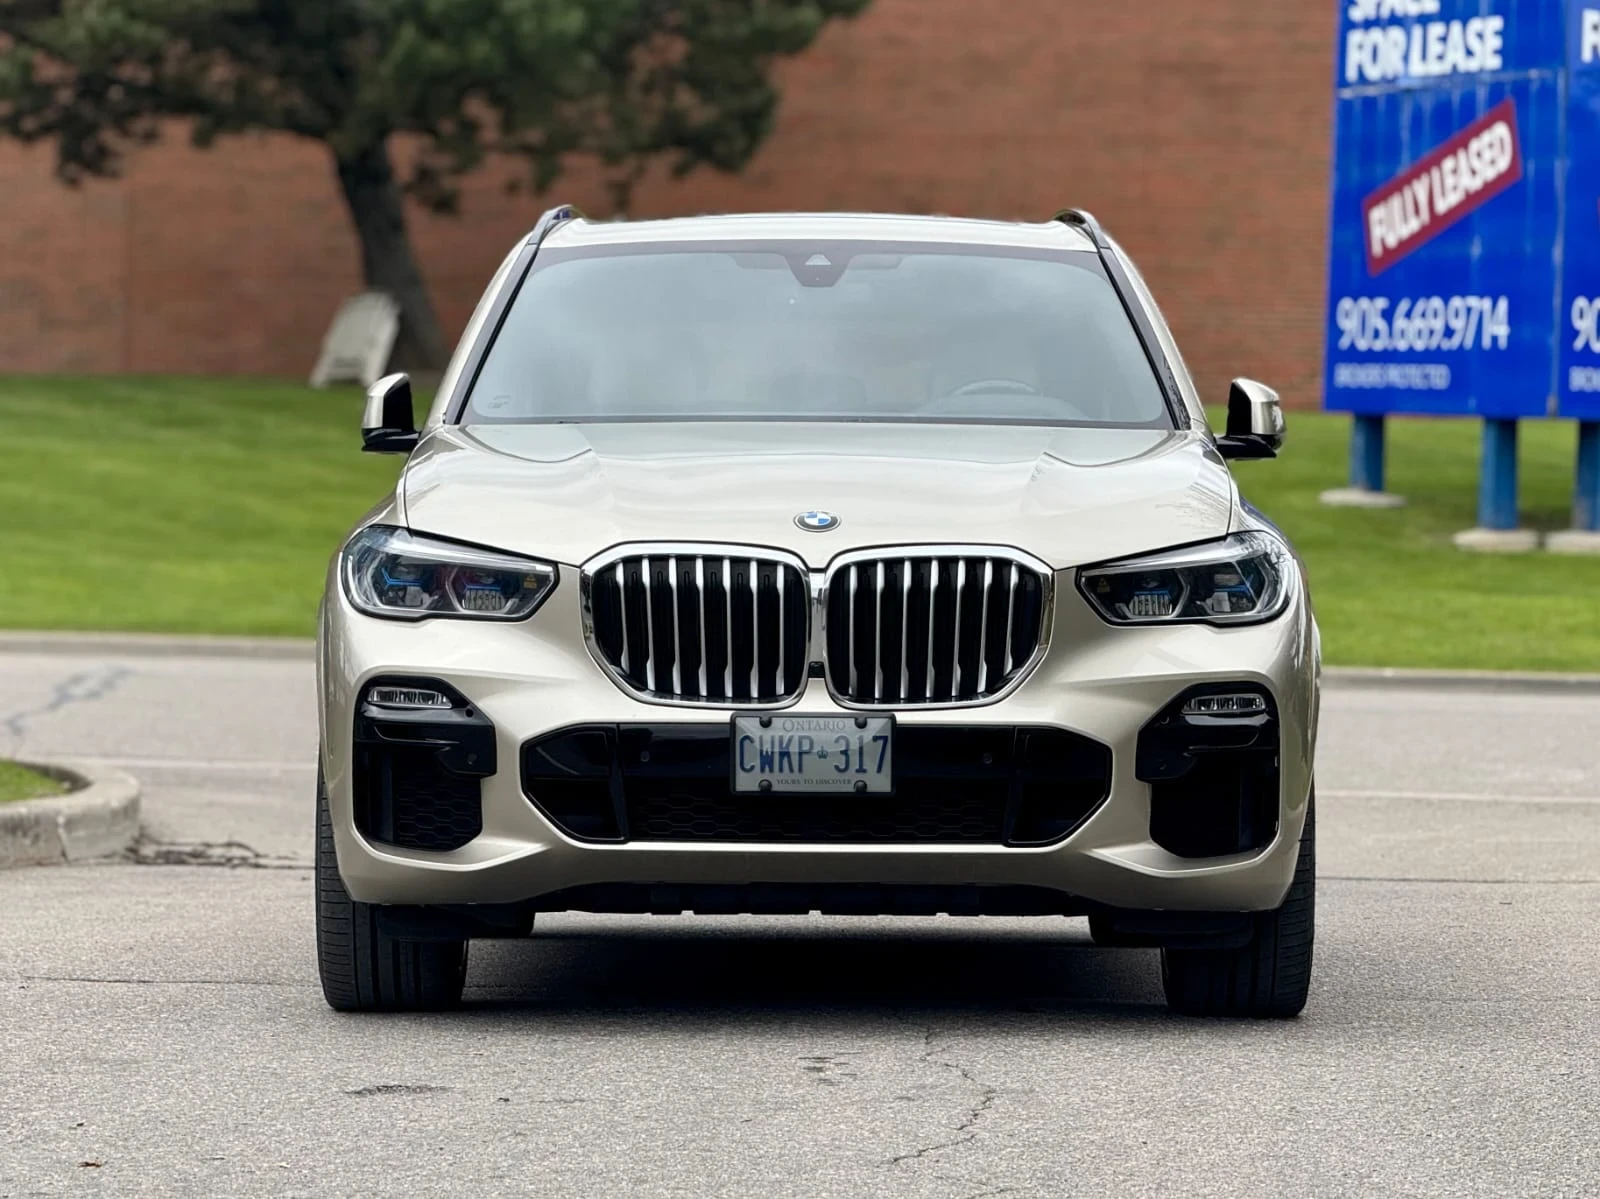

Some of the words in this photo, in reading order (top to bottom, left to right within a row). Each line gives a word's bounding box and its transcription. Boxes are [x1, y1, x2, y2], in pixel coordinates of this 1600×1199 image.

[1345, 25, 1406, 82] FOR
[1408, 15, 1505, 78] LEASE
[1368, 172, 1431, 259] FULLY
[1430, 120, 1513, 217] LEASED
[1335, 294, 1511, 352] 905.669.9714
[739, 735, 815, 774] CWKP
[834, 735, 889, 774] 317
[783, 719, 846, 733] ONTARIO
